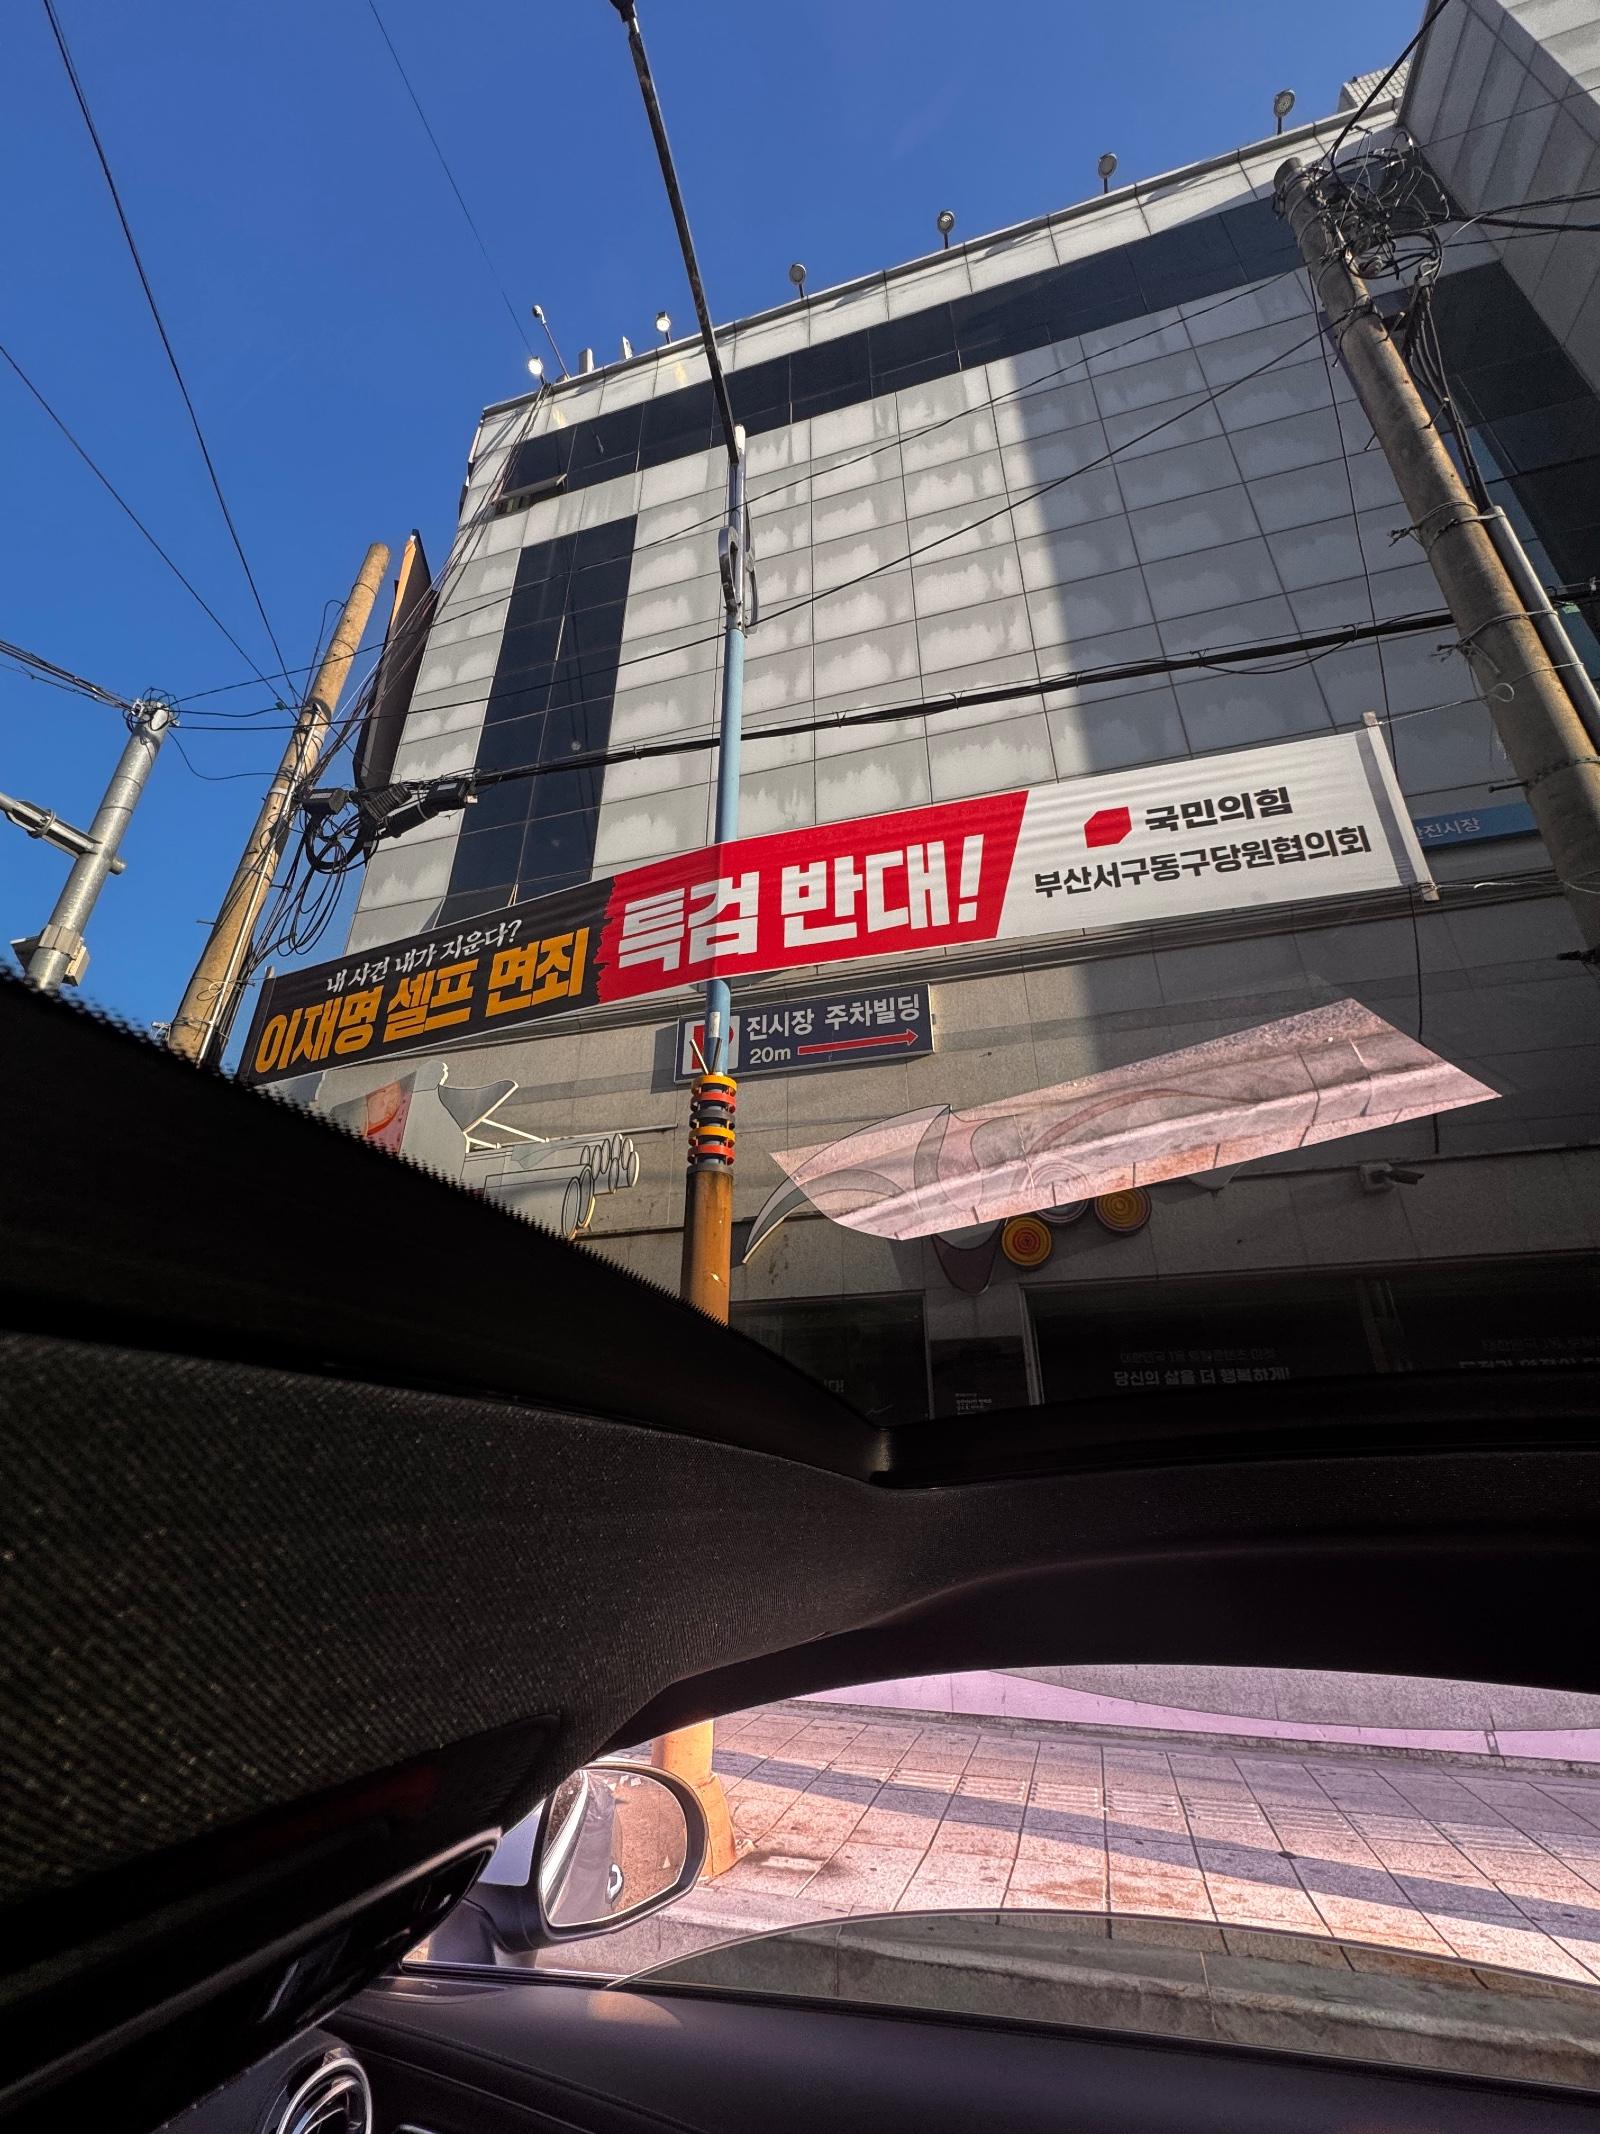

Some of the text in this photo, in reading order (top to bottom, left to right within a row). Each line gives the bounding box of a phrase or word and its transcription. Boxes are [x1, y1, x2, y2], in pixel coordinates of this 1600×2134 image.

[1145, 787, 1293, 831] 국민의힘
[1034, 825, 1372, 898] 부산서구동구당원협의회
[618, 834, 984, 972] 특검 반대!
[326, 919, 522, 993] 내 사건 내가 지운다?
[254, 926, 589, 1074] 이재명 셀프 면죄
[746, 993, 920, 1041] 진시장 주차빌딩
[750, 1048, 791, 1064] 20m
[1113, 1370, 1160, 1386] 당신의
[1200, 1368, 1216, 1384] 더
